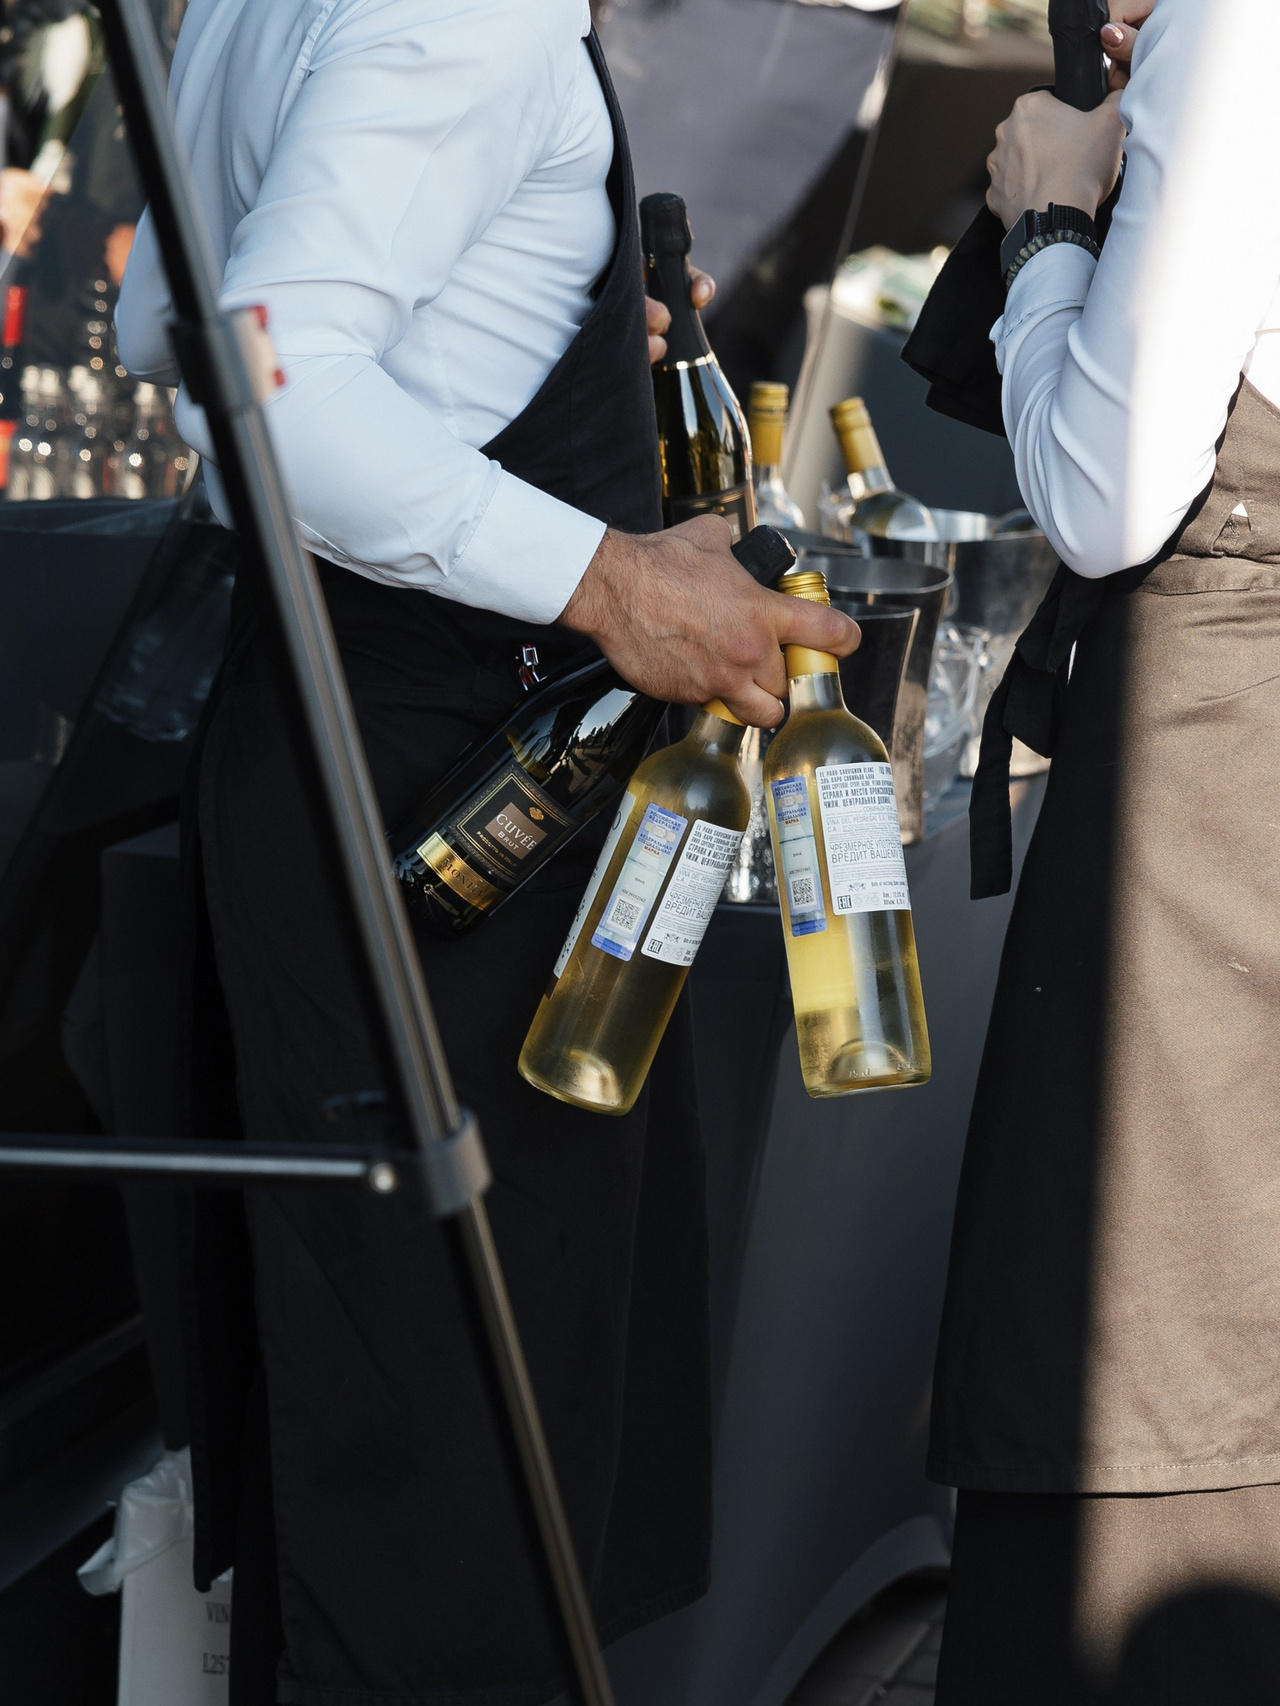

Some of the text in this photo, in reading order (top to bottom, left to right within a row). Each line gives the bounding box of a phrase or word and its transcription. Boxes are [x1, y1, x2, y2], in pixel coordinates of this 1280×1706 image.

[822, 789, 843, 799] СТРАНА
[845, 789, 849, 797] И
[850, 788, 867, 796] МЕСТО
[842, 796, 876, 807] ЦЕНТРАЛЬНАЯ
[493, 810, 538, 851] CUVÉE
[496, 830, 520, 851] BRUT
[829, 839, 874, 852] ЧРЕЗМЕРНОЕ
[643, 845, 660, 855] МАРКА
[687, 842, 707, 855] СТРАНА
[831, 850, 867, 863] ВРЕДИТ
[667, 891, 706, 910] ЧРЕЗМЕРНОЕ
[663, 899, 697, 918] ВРЕДИТ
